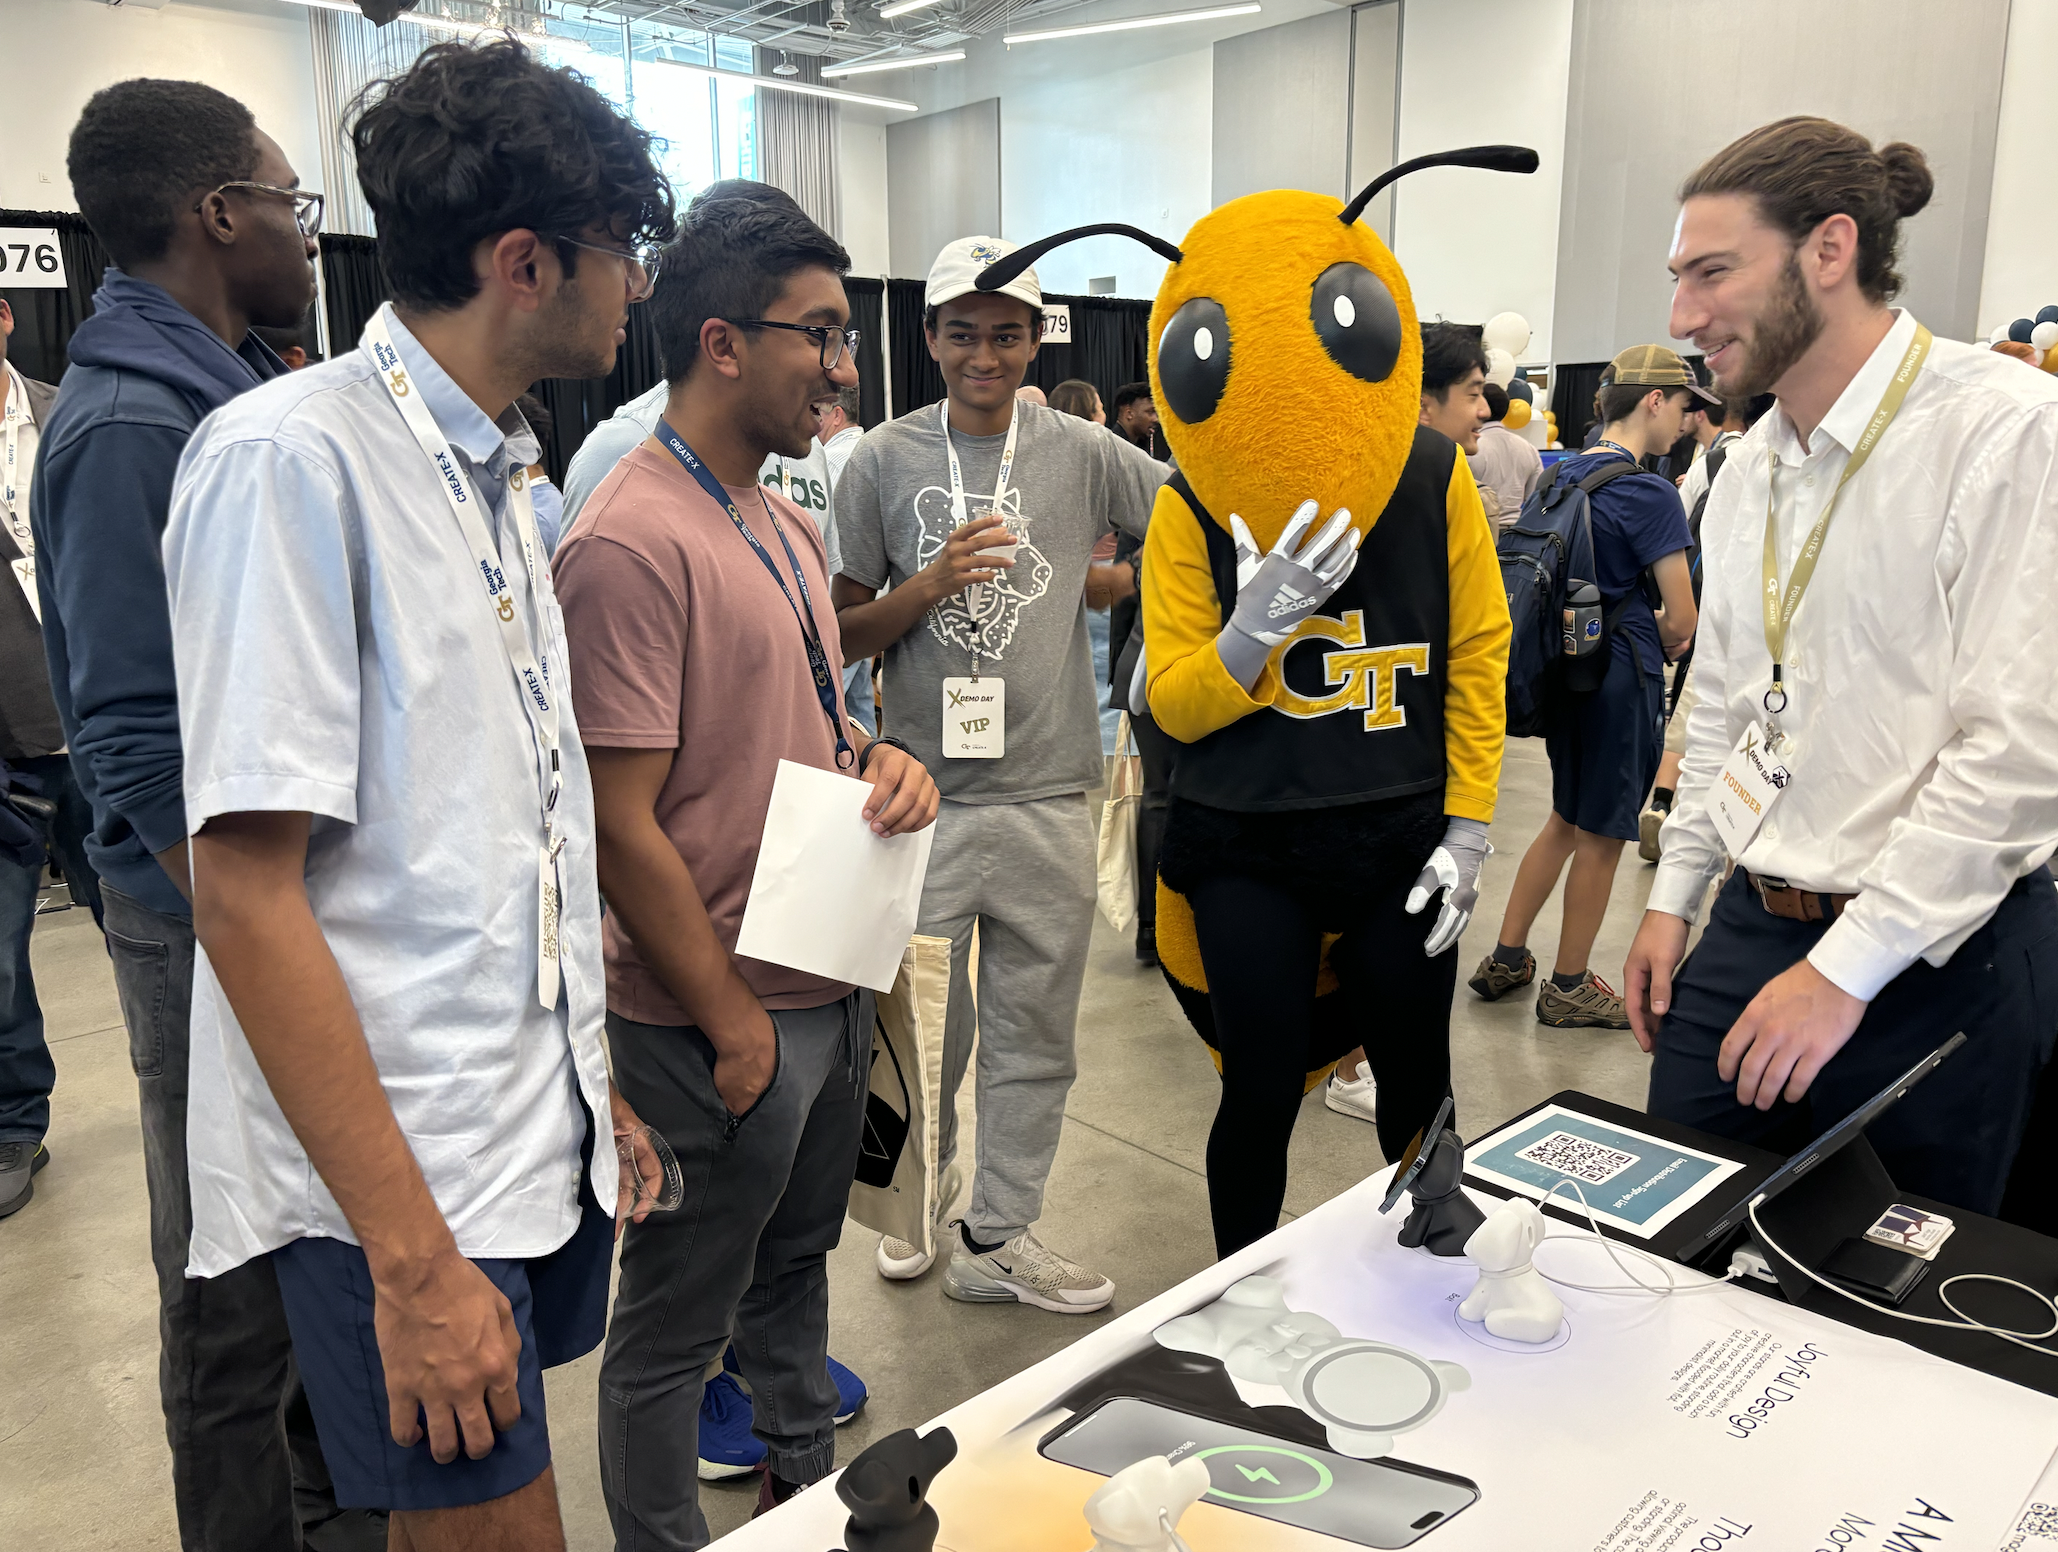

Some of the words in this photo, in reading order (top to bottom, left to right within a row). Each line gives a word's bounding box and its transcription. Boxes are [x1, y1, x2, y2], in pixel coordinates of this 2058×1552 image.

[373, 341, 390, 371] Georgia
[1896, 343, 1923, 383] FOUNDER
[390, 369, 410, 397] GT
[1860, 409, 1888, 451] CREATE-X
[669, 437, 700, 470] CREATE-X
[434, 451, 467, 503] CREATE-X
[951, 460, 960, 488] CREATE-X
[1804, 519, 1825, 560] CREATE-X
[480, 559, 498, 596] Georgia
[497, 595, 514, 622] GT
[1267, 595, 1317, 619] adidas
[1783, 585, 1801, 623] FOUNDER
[1267, 609, 1431, 732] GT
[522, 667, 549, 712] CREATE-X
[959, 717, 990, 735] VIP
[1749, 749, 1763, 772] DEMO
[1760, 769, 1773, 786] DAY
[1722, 771, 1762, 816] FOUNDER
[1689, 1339, 1716, 1363] minimalist
[1727, 1348, 1741, 1361] your
[1751, 1333, 1772, 1353] creative
[1769, 1343, 1782, 1353] Our
[1706, 1347, 1726, 1365] market
[1713, 1361, 1730, 1373] daily
[1726, 1353, 1754, 1380] characters
[1753, 1353, 1771, 1370] stands
[1773, 1342, 1829, 1390] Joyful
[1688, 1364, 1711, 1384] flooded
[1744, 1370, 1756, 1379] are
[1677, 1382, 1691, 1393] with
[1727, 1379, 1747, 1399] crafted
[1674, 1391, 1700, 1412] standing
[1688, 1404, 1708, 1418] touch
[1716, 1398, 1730, 1408] with
[1725, 1386, 1794, 1439] Design
[1629, 1490, 1657, 1514] allowing
[1661, 1498, 1670, 1507] or
[1662, 1502, 1686, 1526] optimal
[1905, 1497, 1954, 1523] A
[1601, 1514, 1634, 1546] customers
[1680, 1517, 1698, 1528] The
[1690, 1516, 1753, 1552] Tho
[1622, 1534, 1640, 1546] The
[1638, 1525, 1667, 1548] viewing
